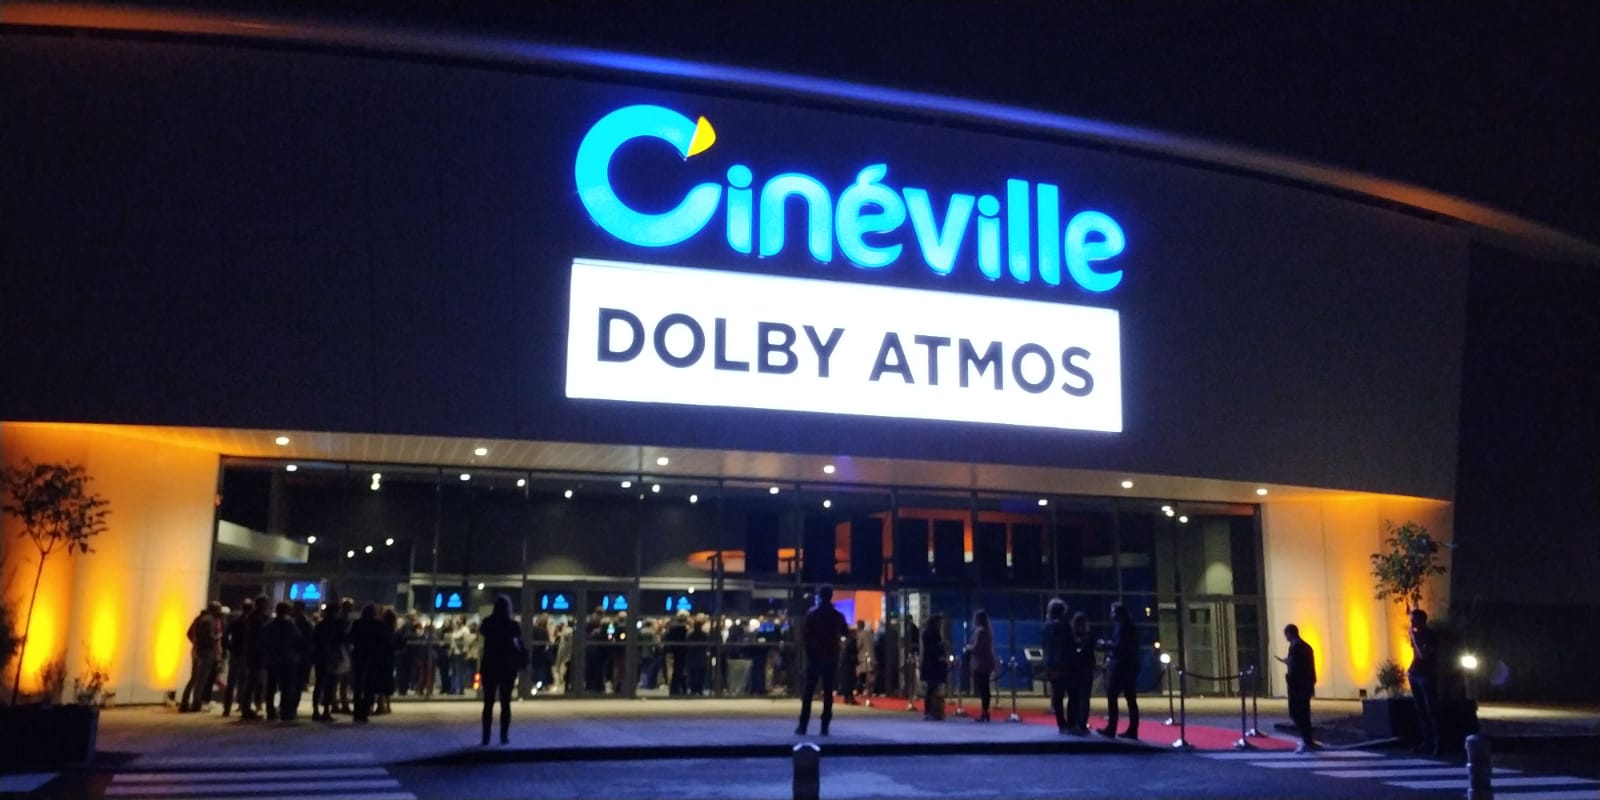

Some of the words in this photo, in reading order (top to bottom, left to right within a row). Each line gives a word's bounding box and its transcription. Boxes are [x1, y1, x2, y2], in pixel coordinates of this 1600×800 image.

[575, 104, 1126, 292] Cinéville
[597, 307, 844, 377] DOLBY
[871, 332, 1095, 397] ATMOS
